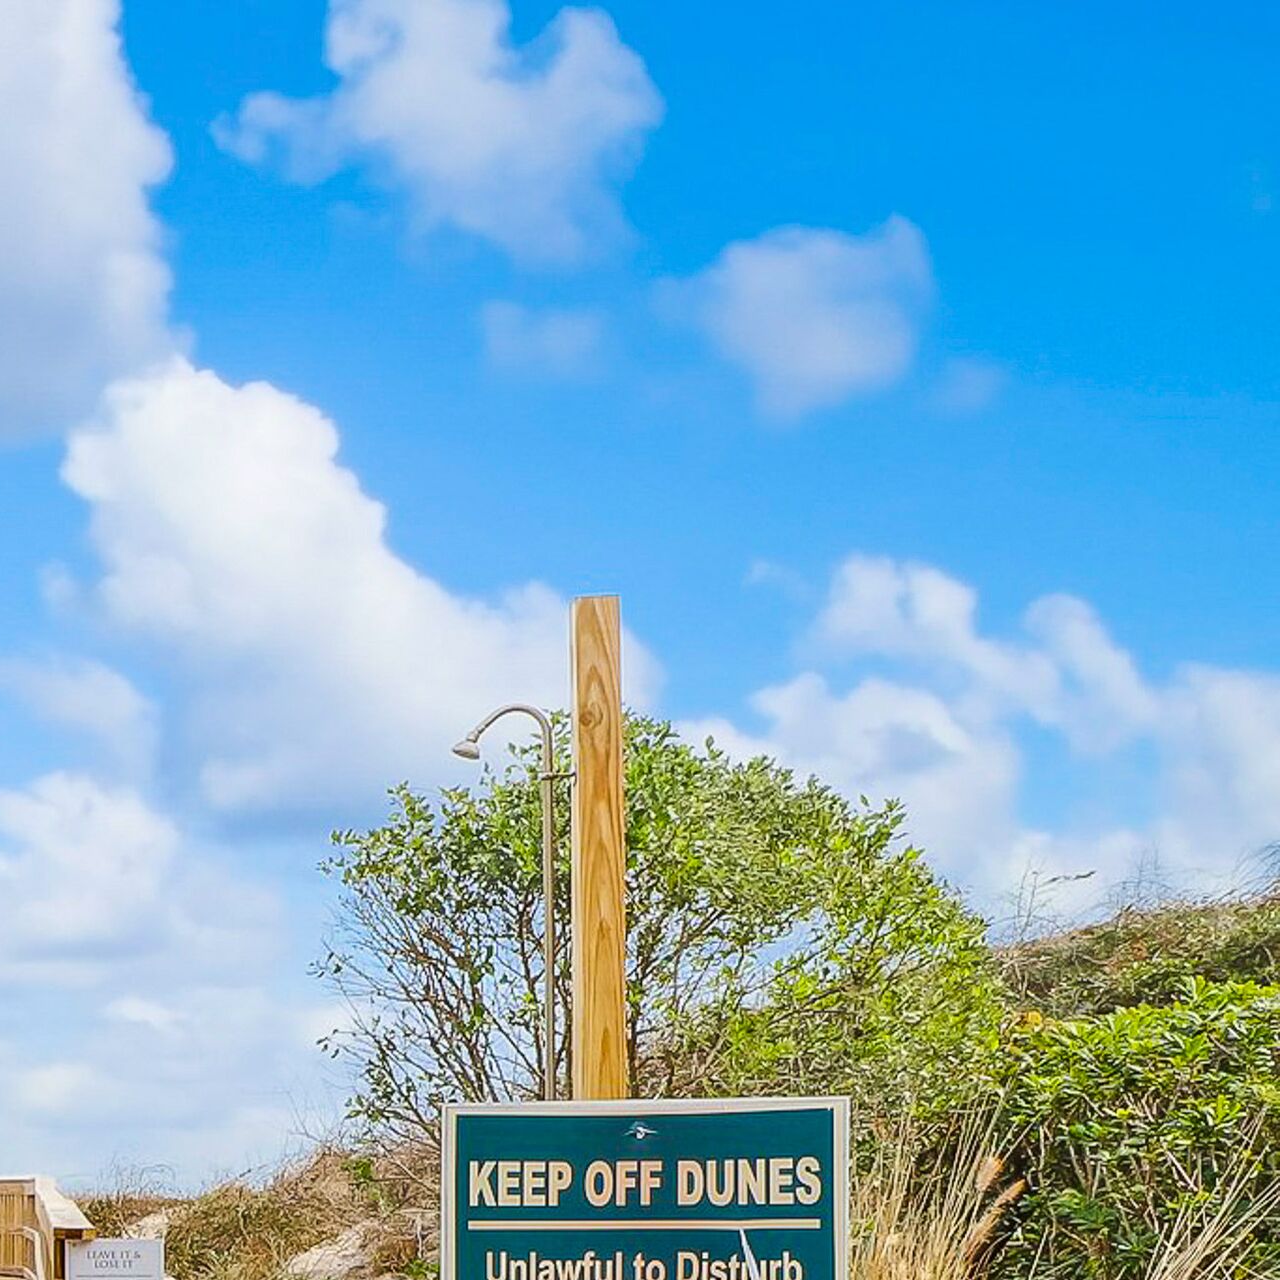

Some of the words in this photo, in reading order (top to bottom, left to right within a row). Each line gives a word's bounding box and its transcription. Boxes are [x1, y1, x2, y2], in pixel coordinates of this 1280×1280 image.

[468, 1160, 572, 1207] KEEP
[584, 1160, 664, 1207] OFF
[676, 1157, 822, 1207] DUNES
